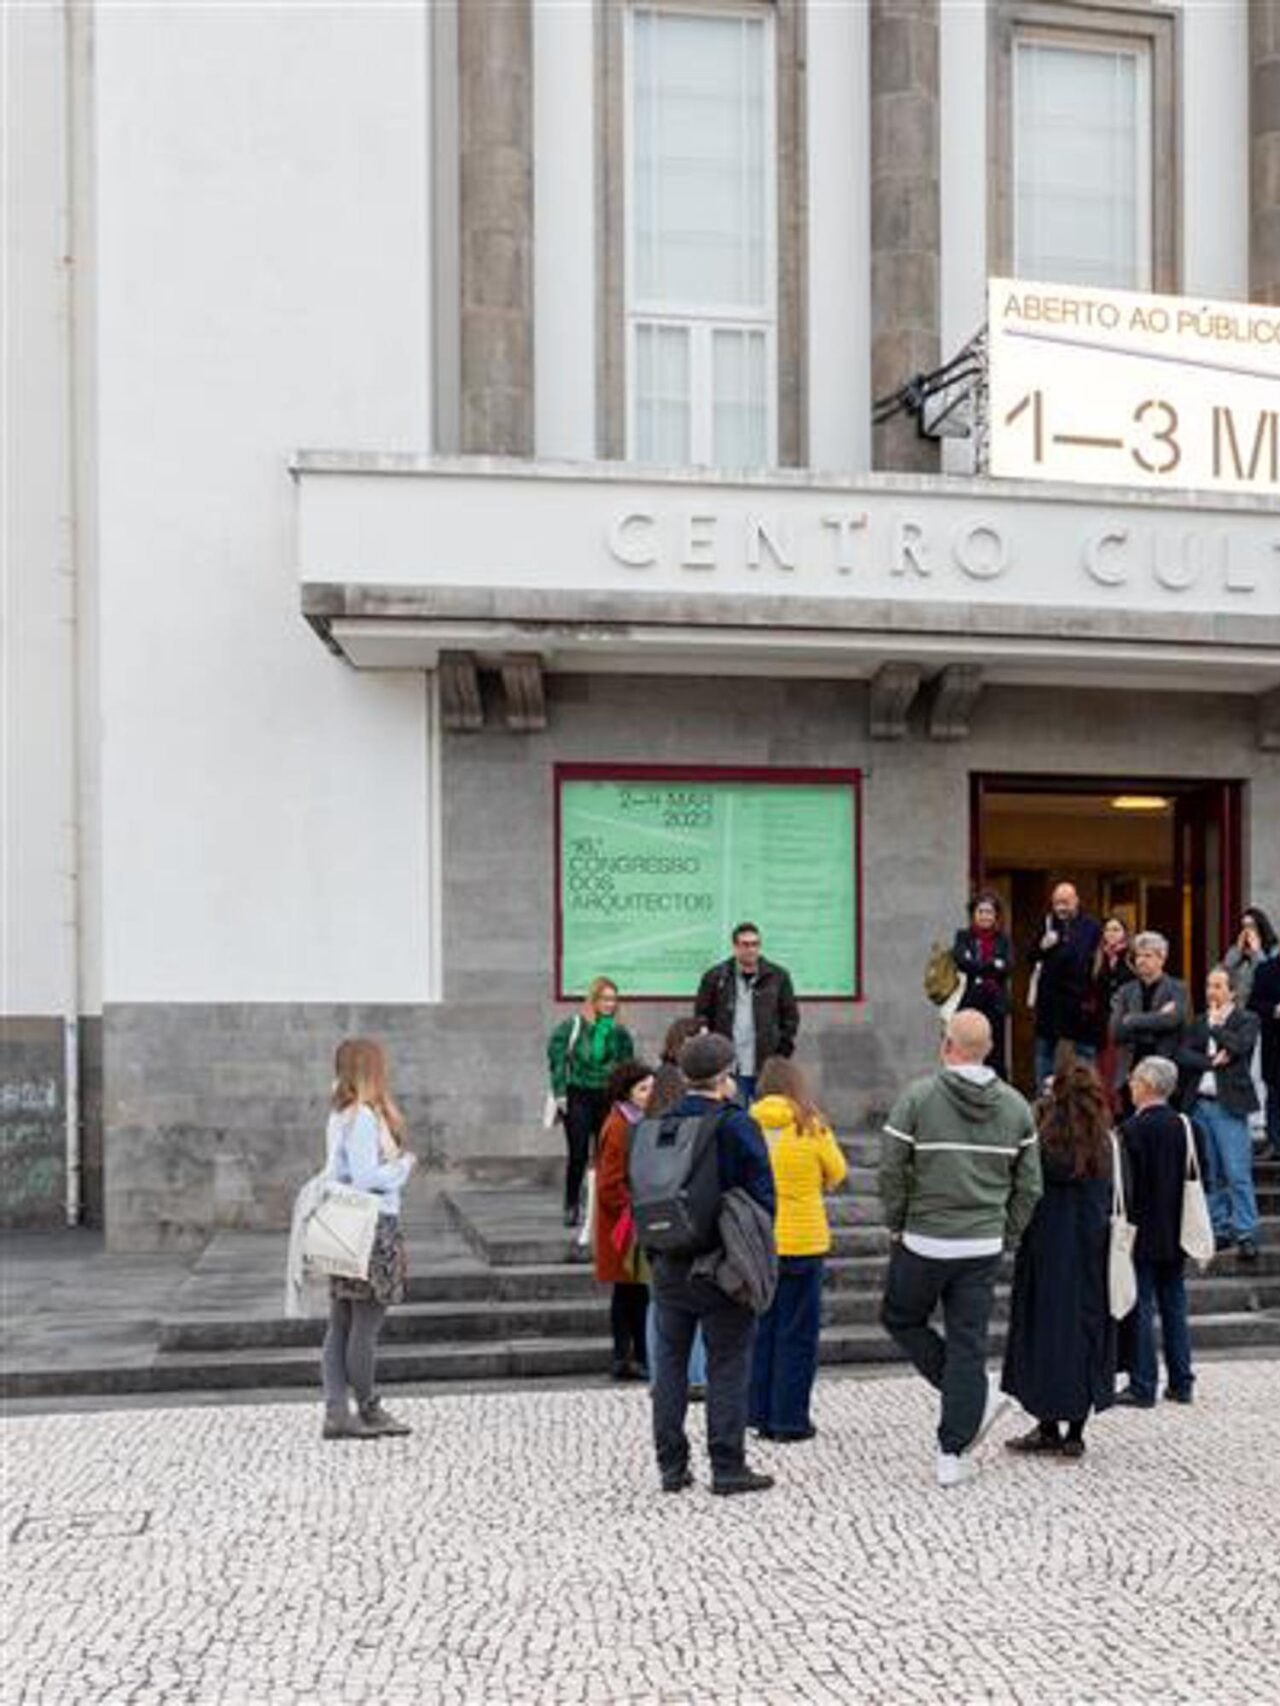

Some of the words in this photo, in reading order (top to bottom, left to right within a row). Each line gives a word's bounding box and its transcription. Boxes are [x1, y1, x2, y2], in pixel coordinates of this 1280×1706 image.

[1003, 293, 1121, 329] ABERTO
[1128, 307, 1169, 335] AO
[606, 510, 1012, 582] CENTRO
[569, 856, 700, 875] CONGRESSO
[569, 874, 616, 892] DOS
[570, 891, 714, 914] ARQUITECTOS
